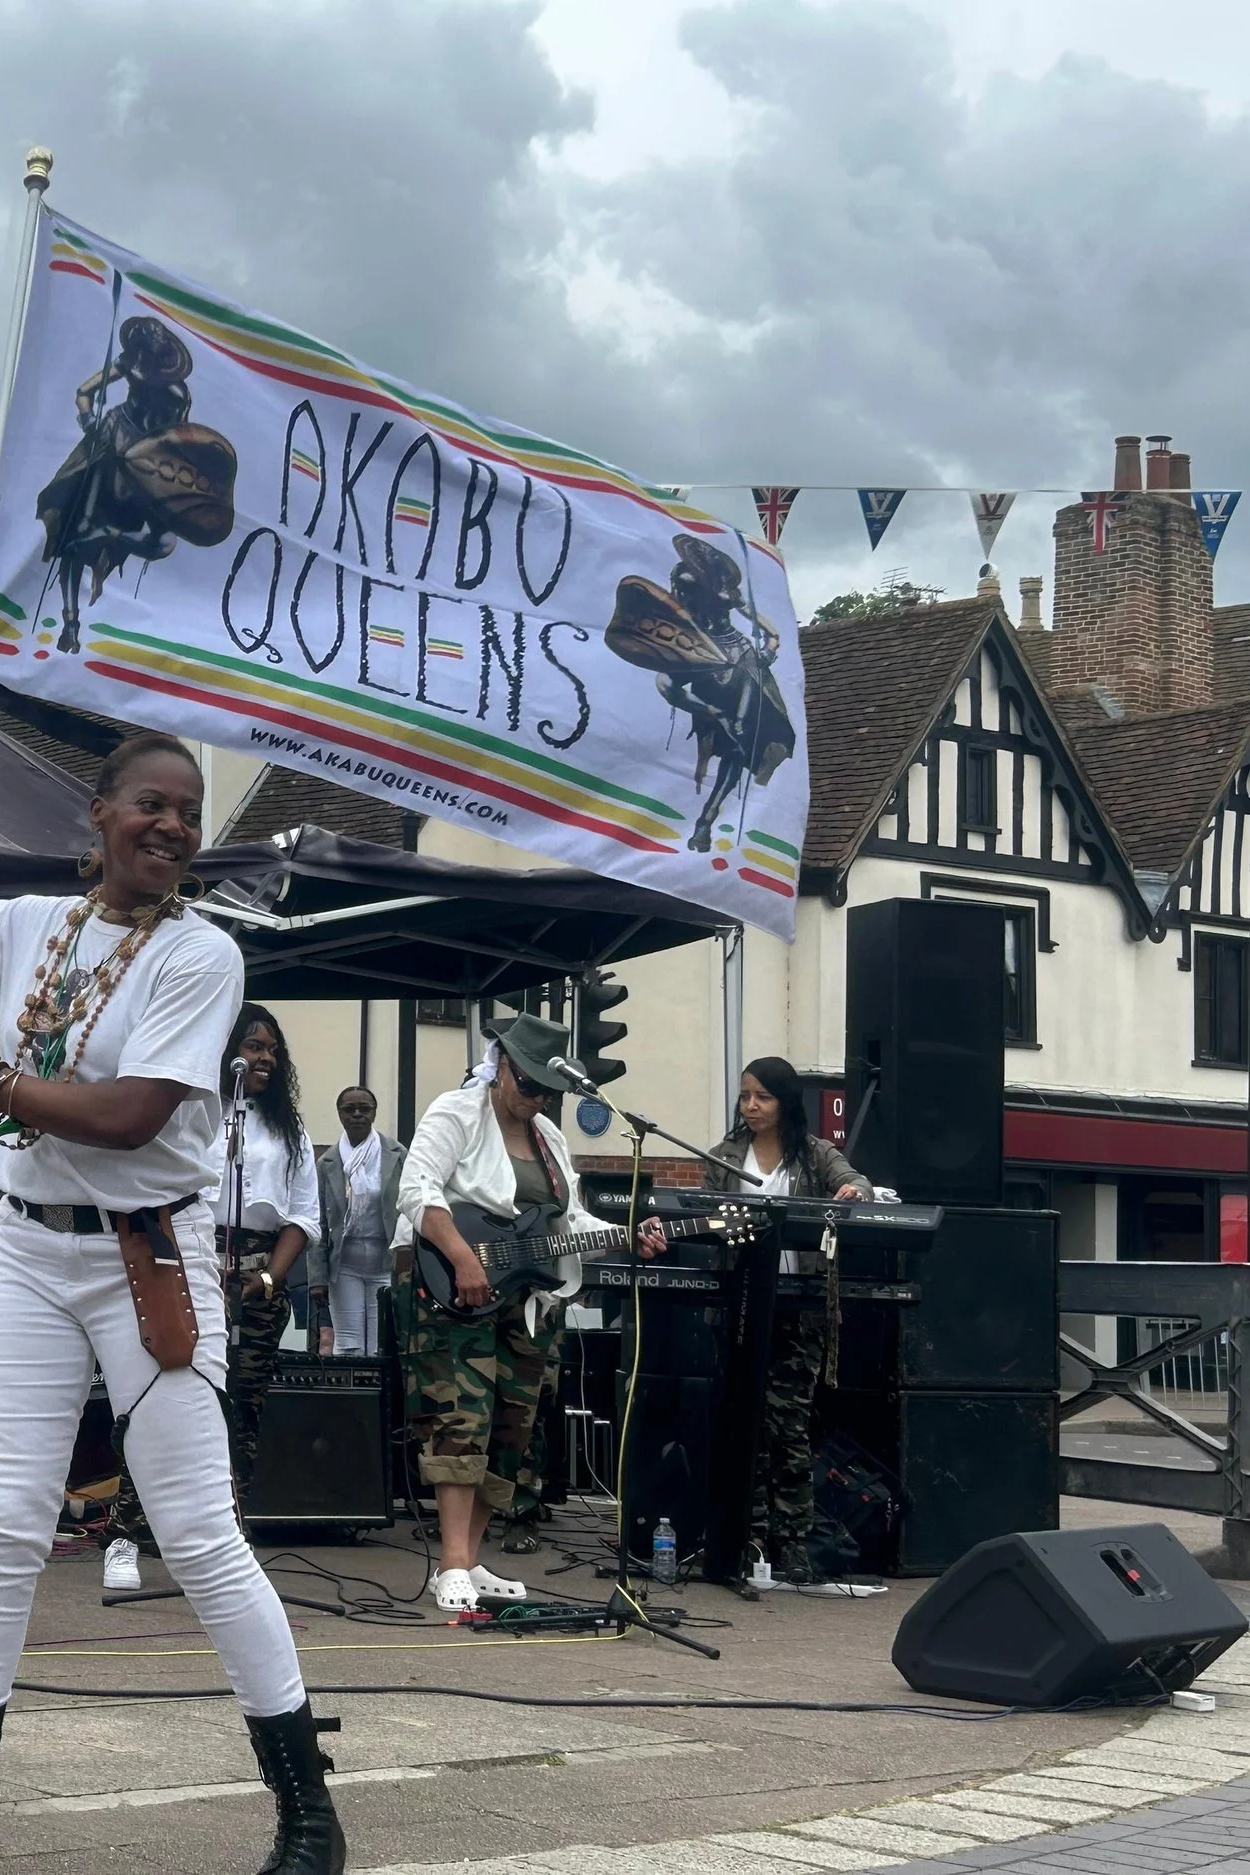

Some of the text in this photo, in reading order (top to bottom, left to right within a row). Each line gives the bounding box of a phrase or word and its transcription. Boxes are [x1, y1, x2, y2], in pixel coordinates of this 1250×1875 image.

[279, 399, 571, 606] AKABU
[222, 526, 591, 750] QUEENS
[250, 727, 508, 826] WWW.AKABUQUEENS.COM
[666, 1278, 720, 1290] JUNO-D
